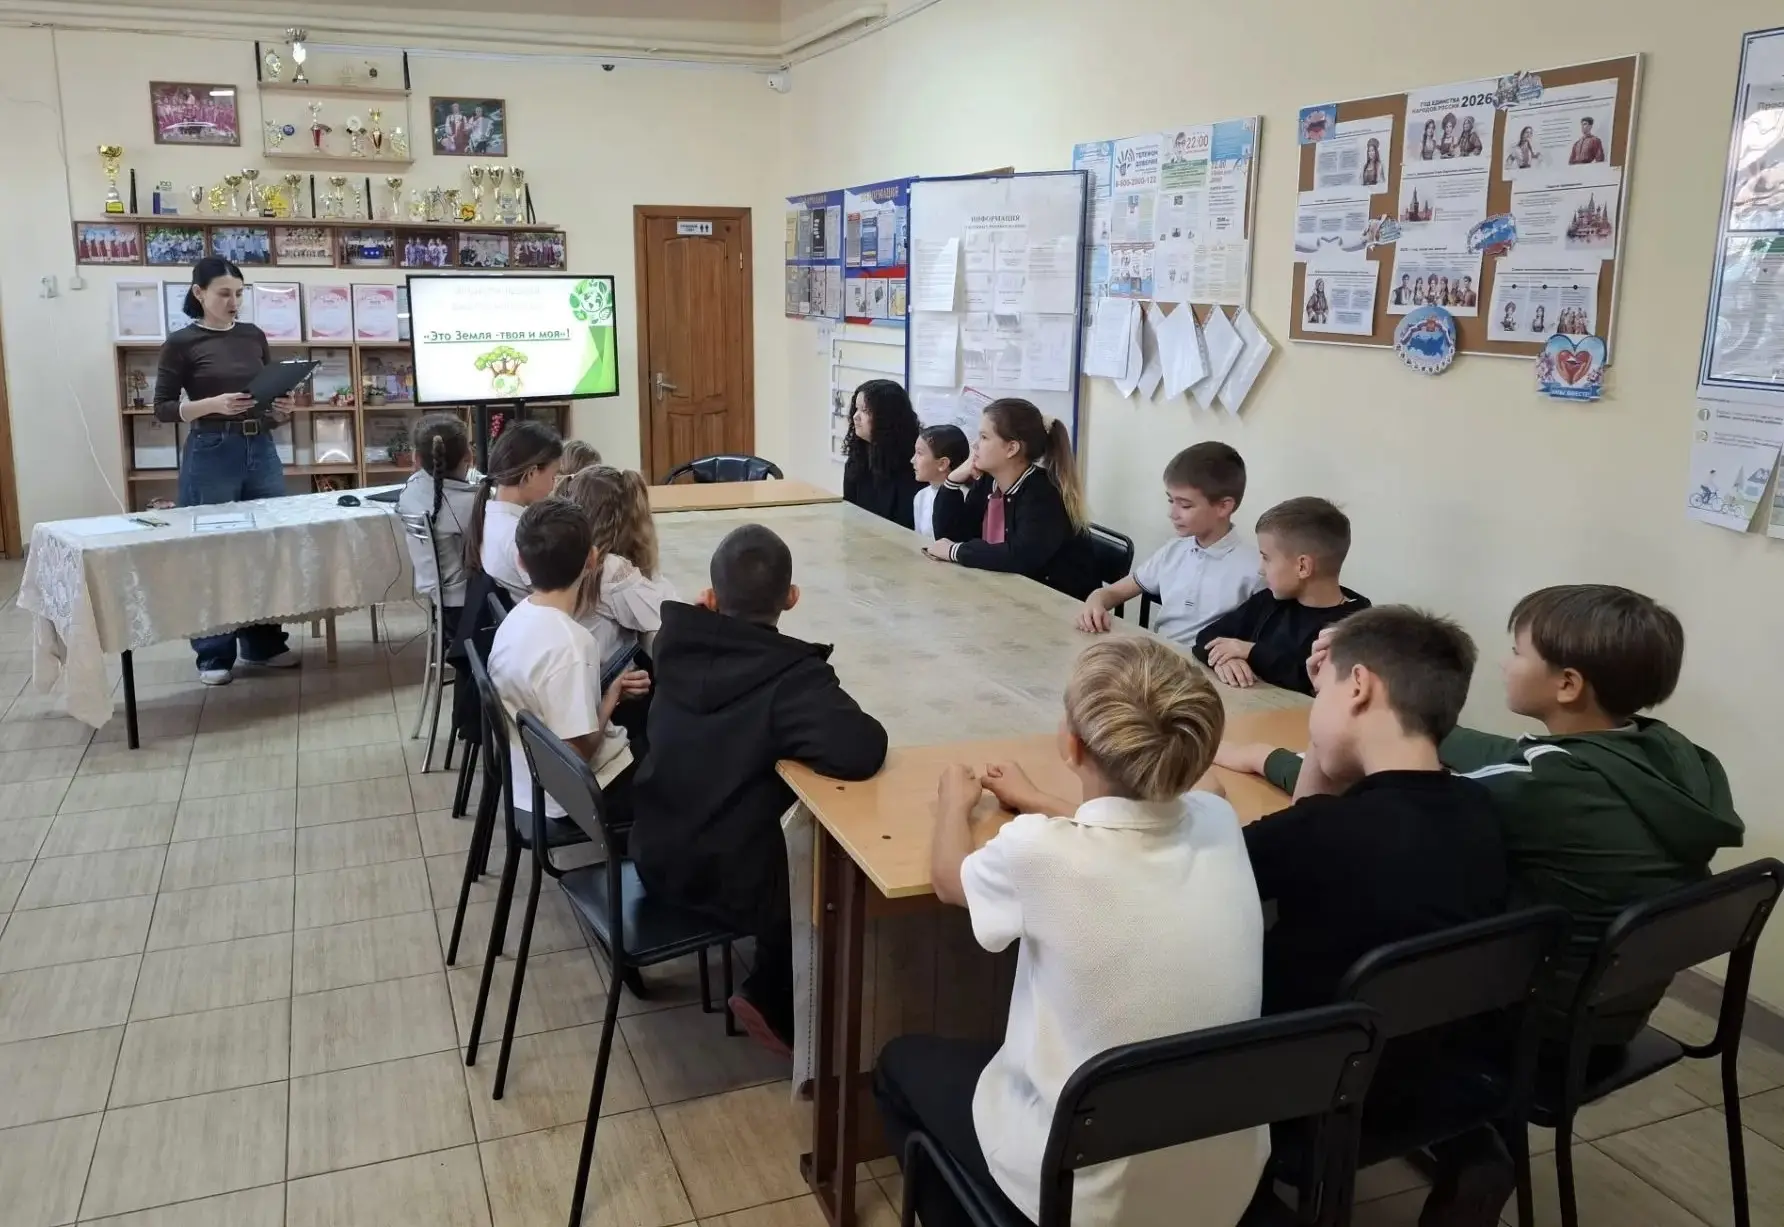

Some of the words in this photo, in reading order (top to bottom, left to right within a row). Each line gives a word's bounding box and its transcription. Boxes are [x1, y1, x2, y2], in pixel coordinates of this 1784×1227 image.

[1460, 93, 1493, 108] 2026
[455, 330, 492, 341] Земля
[528, 331, 535, 339] и
